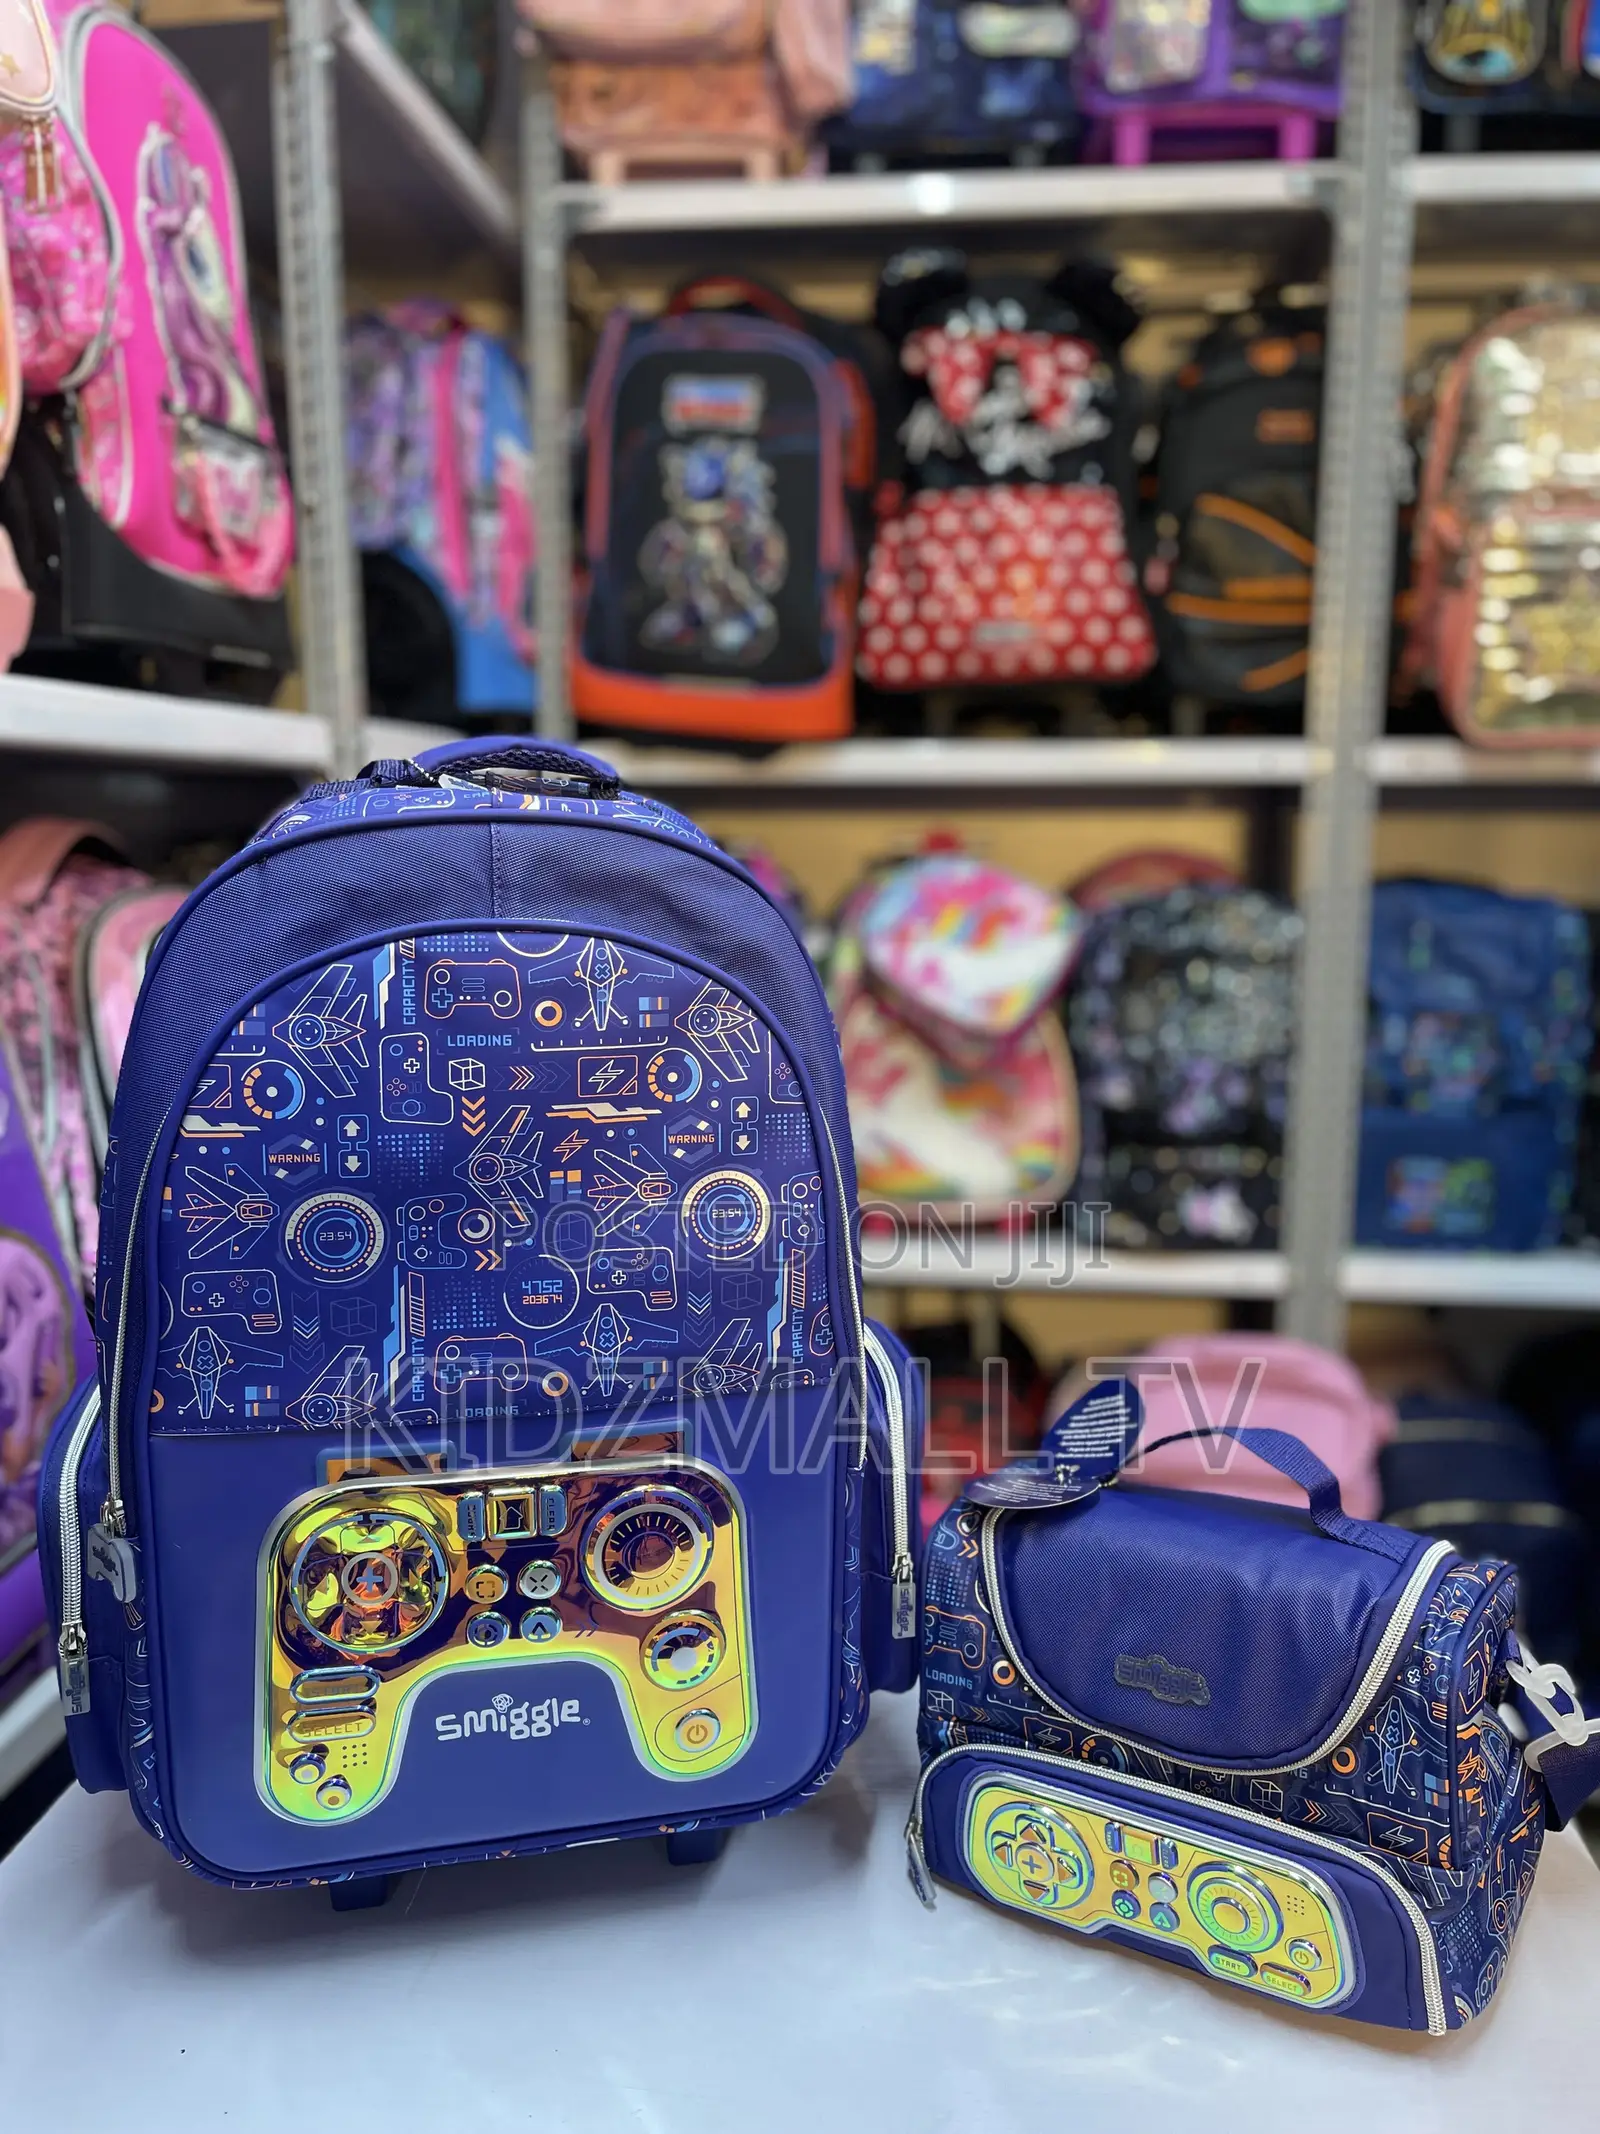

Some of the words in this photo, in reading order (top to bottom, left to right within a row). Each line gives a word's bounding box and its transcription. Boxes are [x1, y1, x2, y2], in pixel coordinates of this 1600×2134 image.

[402, 958, 416, 1025] CAPACITY
[447, 1034, 513, 1047] LOADING
[667, 1133, 716, 1144] WARNING
[268, 1153, 321, 1164] WARNING
[711, 1207, 742, 1218] 23:54
[318, 1231, 353, 1242] 23:54
[521, 1279, 563, 1295] 4752
[522, 1294, 563, 1305] 203674
[792, 1307, 805, 1364] CAPACITY
[410, 1337, 425, 1402] CAPACITY
[455, 1405, 519, 1418] LOADING
[925, 1667, 973, 1690] LOADING
[302, 1721, 363, 1738] SELECT
[1215, 1956, 1242, 1971] START
[1266, 1974, 1298, 1992] SELECT
